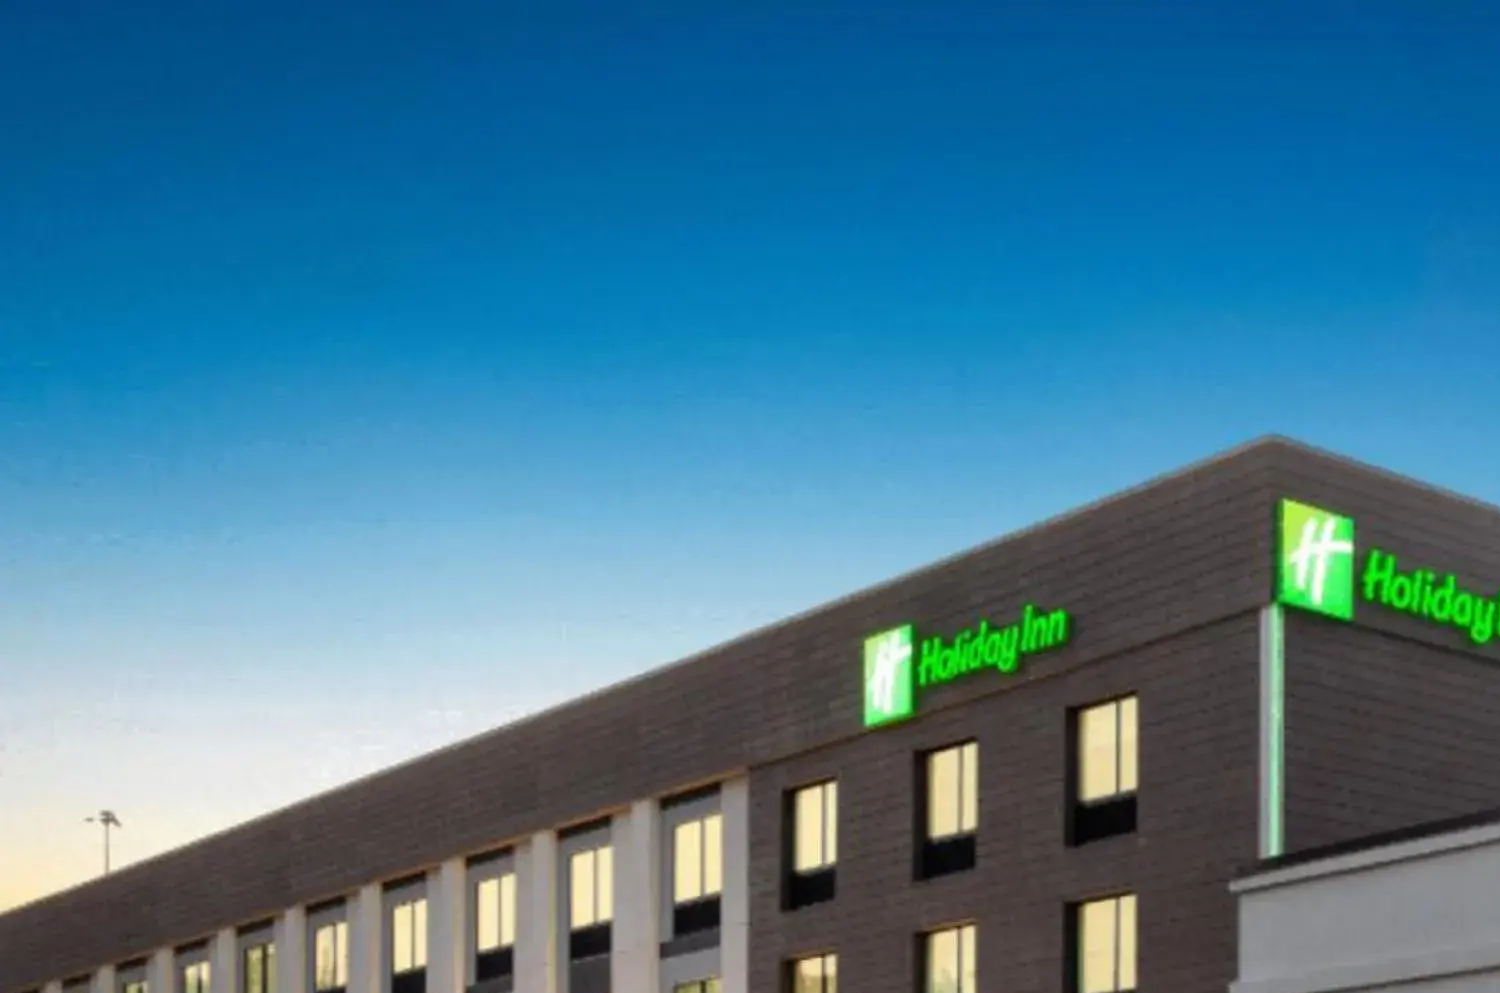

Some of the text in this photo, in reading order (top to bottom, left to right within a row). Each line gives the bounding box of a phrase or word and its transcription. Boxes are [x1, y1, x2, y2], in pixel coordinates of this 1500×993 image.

[1361, 548, 1496, 645] Holiday
[918, 603, 1069, 687] Holiday Inn
